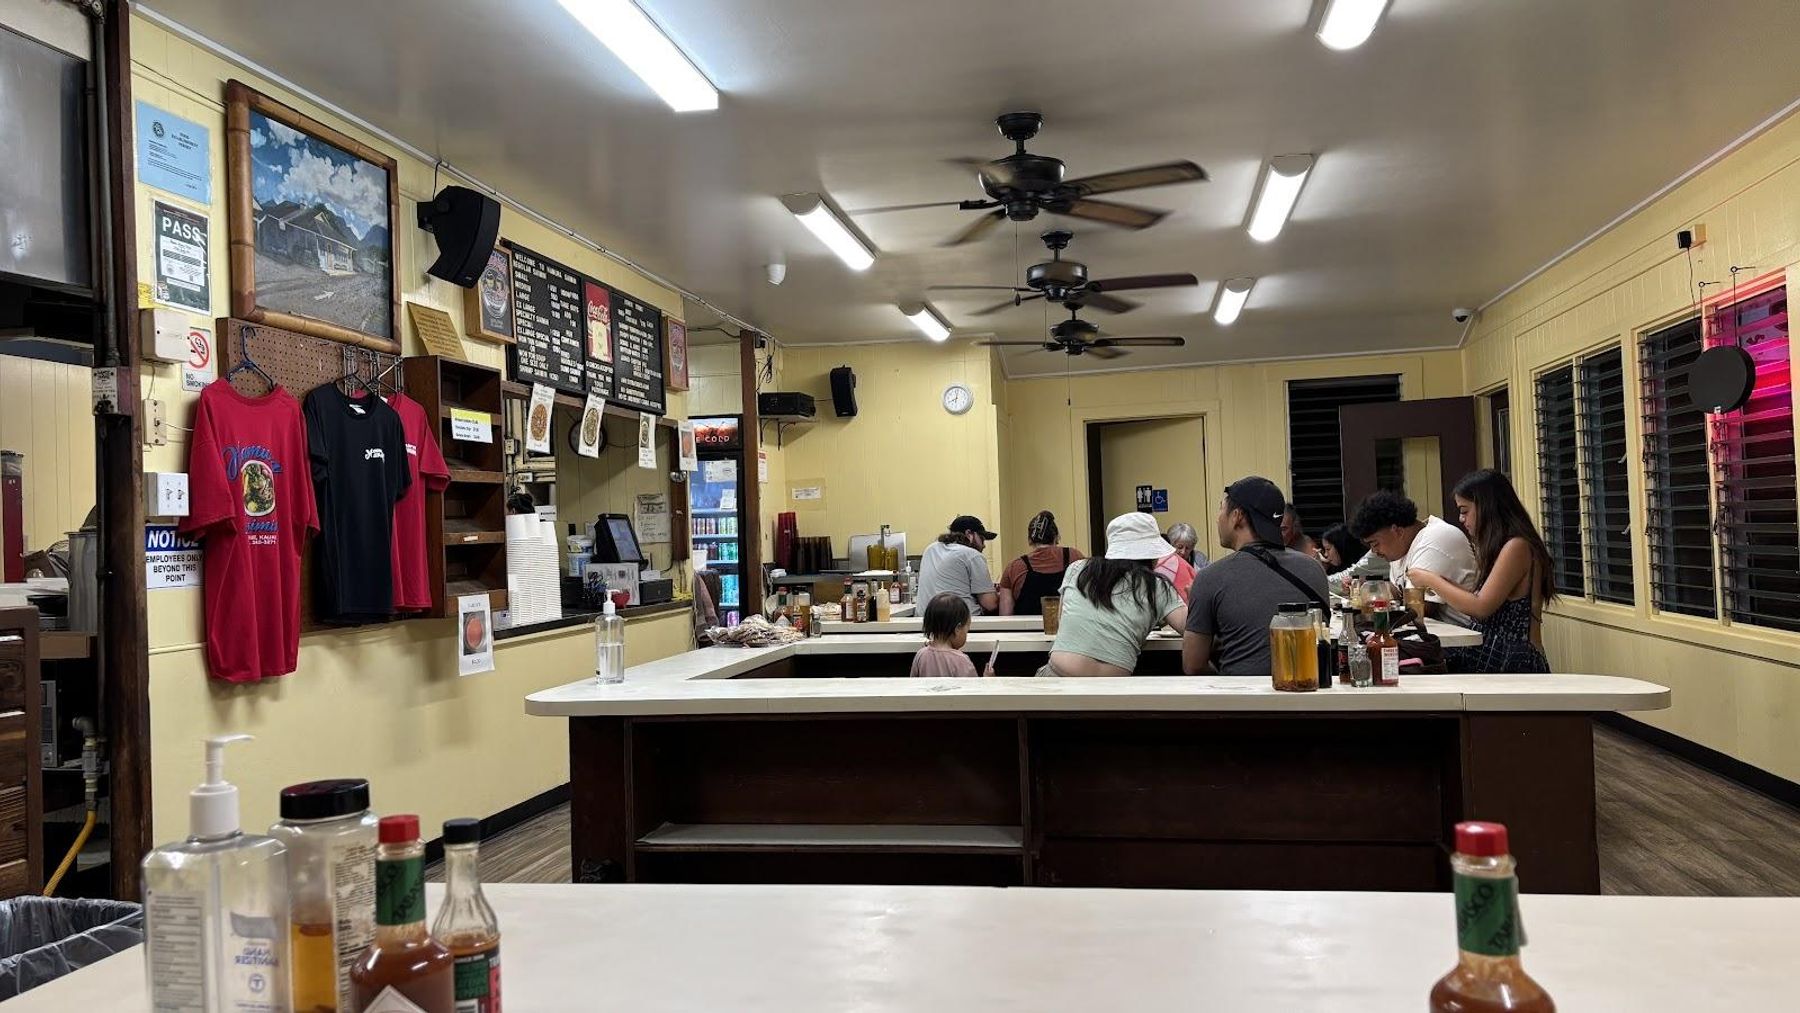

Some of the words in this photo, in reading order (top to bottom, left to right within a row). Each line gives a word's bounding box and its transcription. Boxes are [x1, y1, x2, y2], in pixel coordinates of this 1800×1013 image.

[162, 216, 200, 242] PASS
[186, 380, 208, 388] SMOKIN
[704, 435, 730, 443] COLD
[146, 554, 185, 563] EMPLOYEES
[153, 564, 180, 573] BEYOND
[182, 563, 197, 571] THIS
[165, 574, 186, 582] POINT
